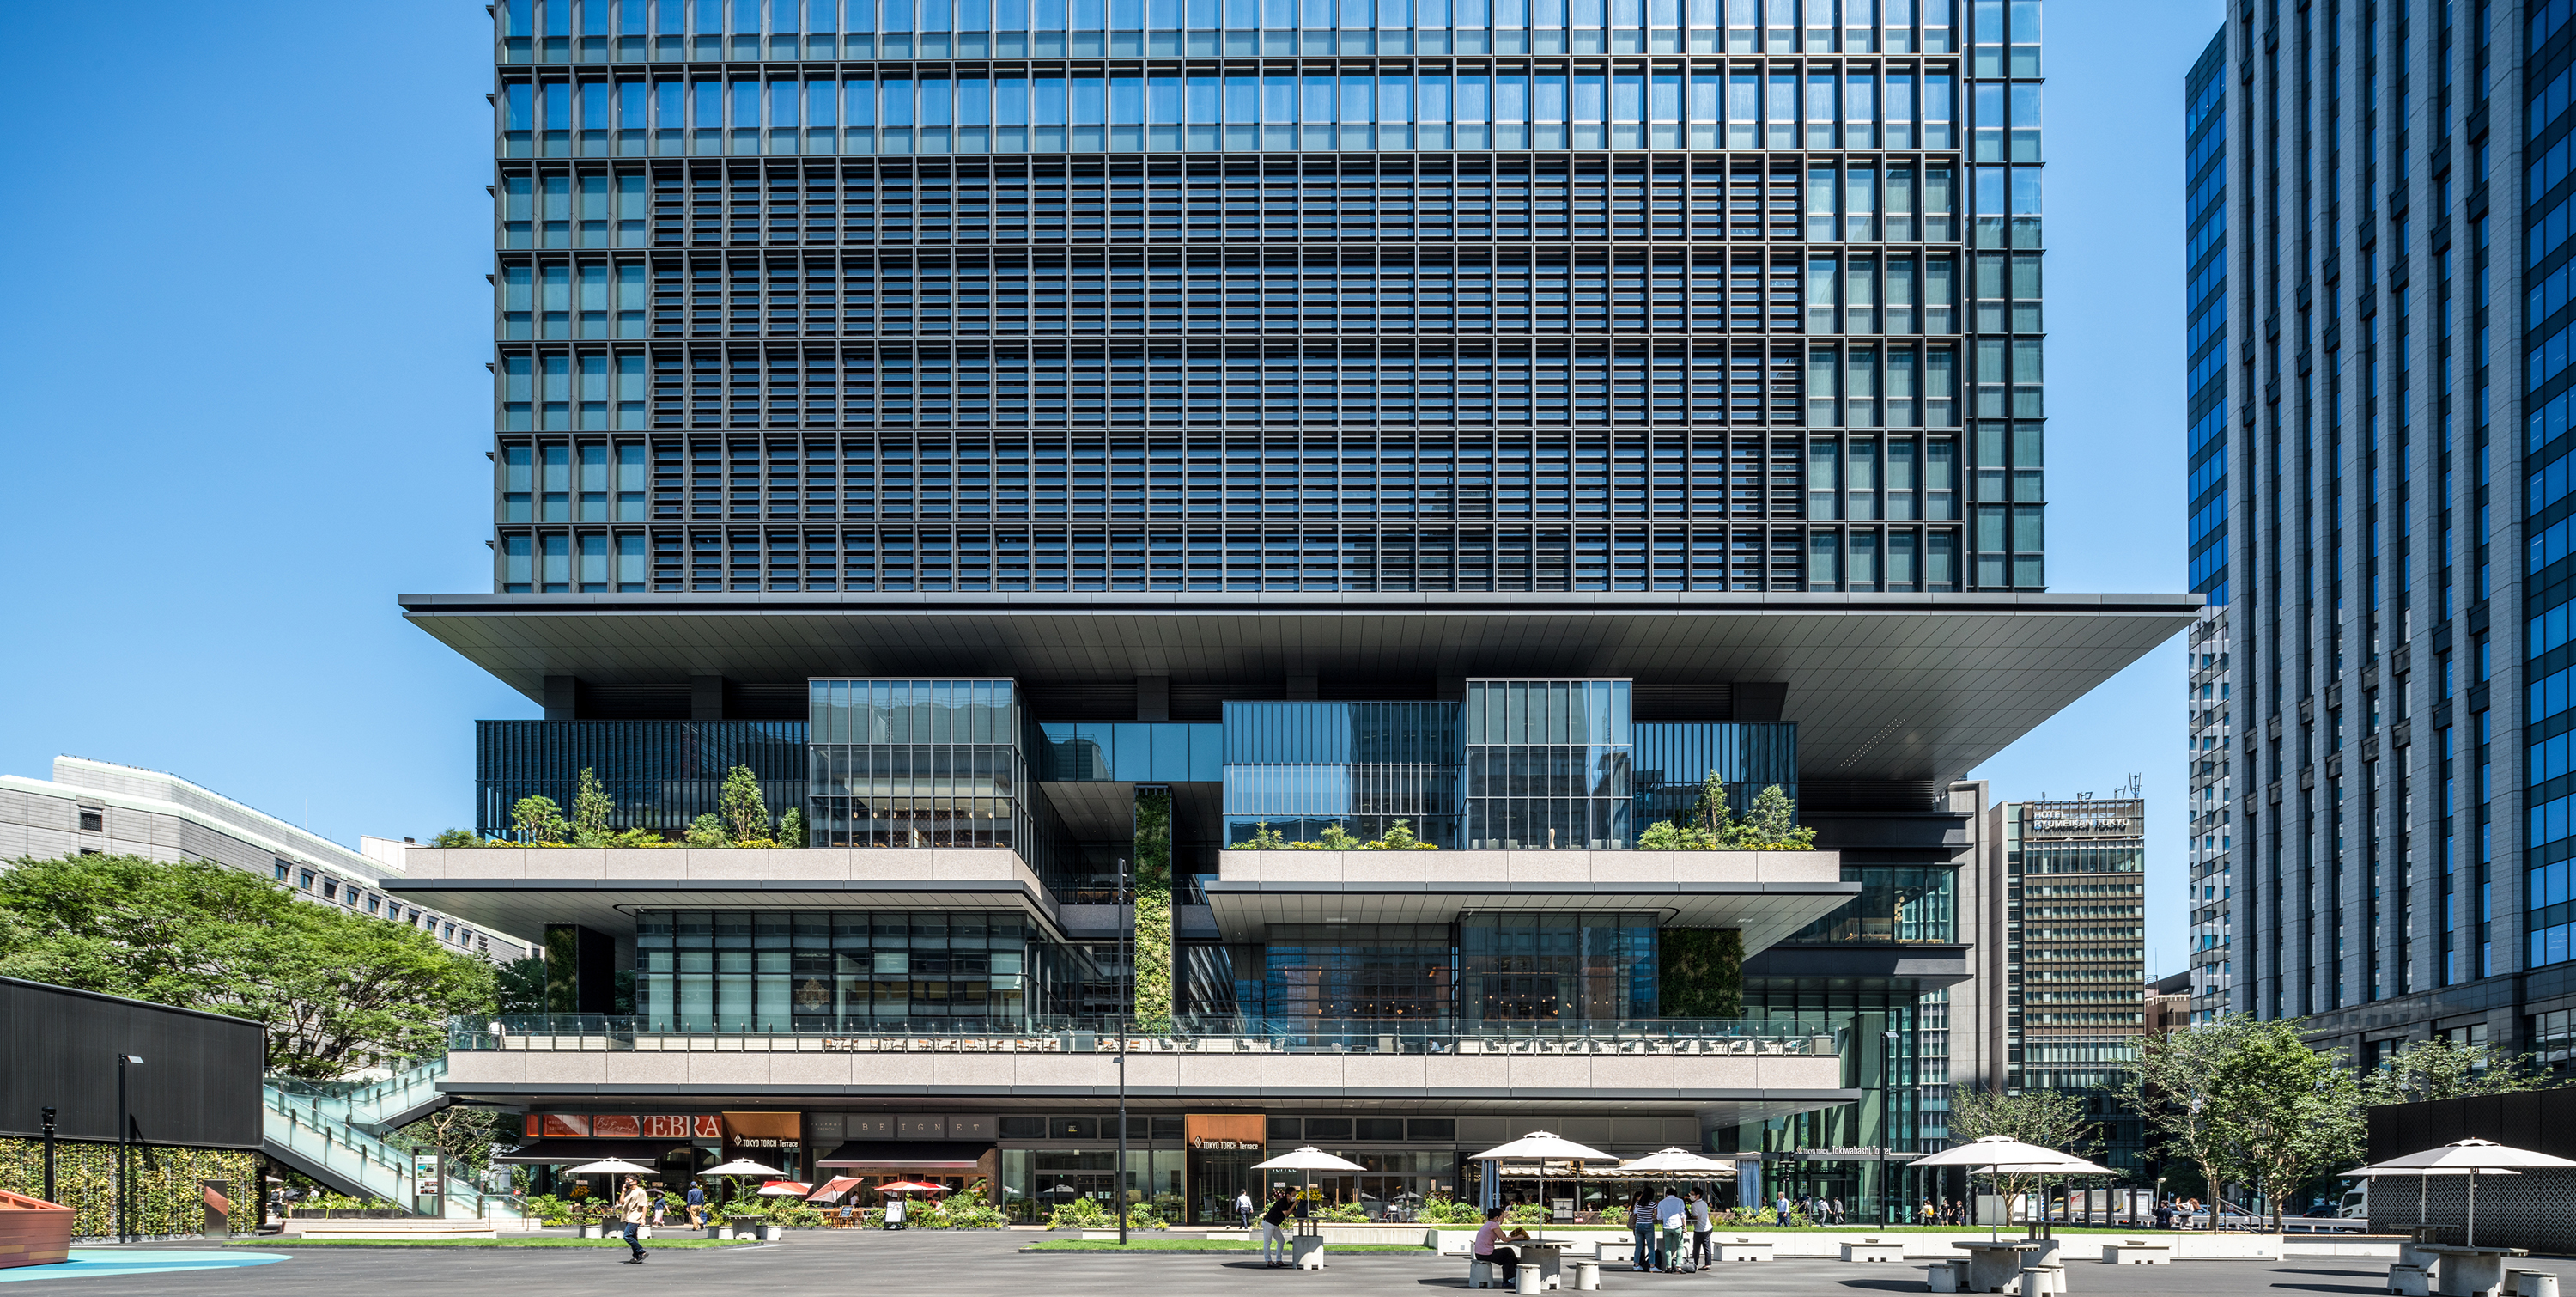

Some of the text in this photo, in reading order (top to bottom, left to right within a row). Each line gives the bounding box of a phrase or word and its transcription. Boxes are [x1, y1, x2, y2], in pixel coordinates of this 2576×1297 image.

[2033, 810, 2064, 819] HOTEL
[2033, 818, 2129, 828] RYUMEIKAN TOKYO
[631, 1115, 721, 1137] YEBRA
[860, 1123, 980, 1131] BEIGNET
[743, 1139, 799, 1148] TOKYO TORCH Terrace
[1203, 1142, 1259, 1150] TOKYO TORCH Terrace
[1832, 1145, 1871, 1155] Tokiwabashi
[1872, 1145, 1892, 1155] Toer
